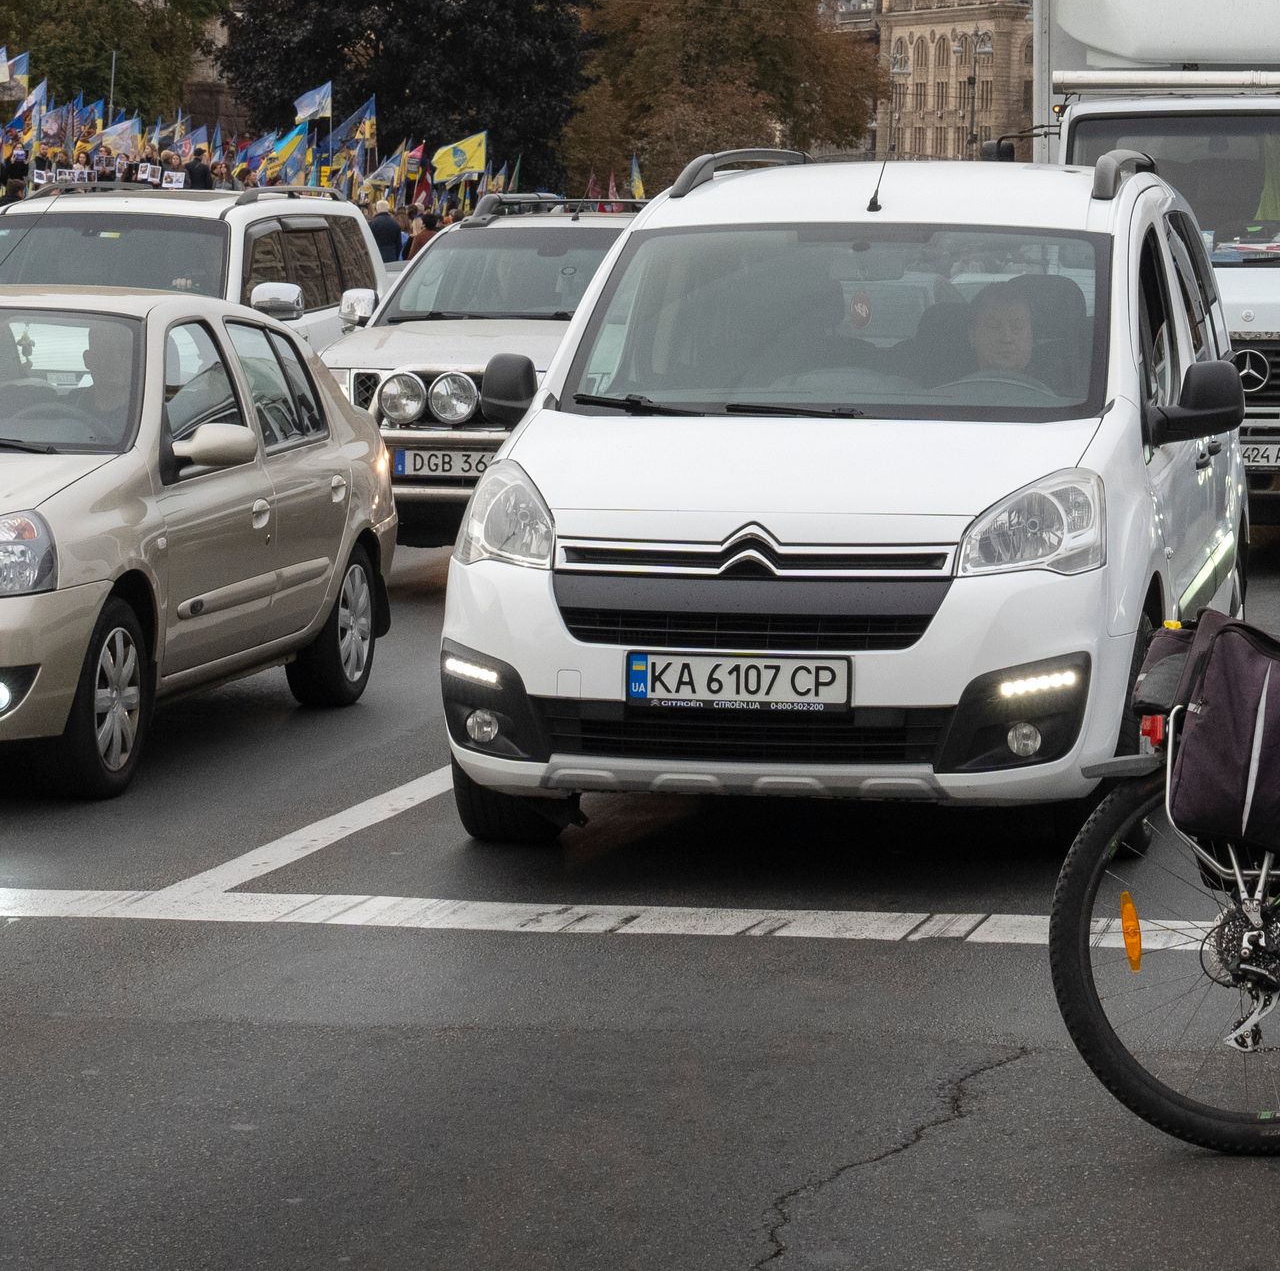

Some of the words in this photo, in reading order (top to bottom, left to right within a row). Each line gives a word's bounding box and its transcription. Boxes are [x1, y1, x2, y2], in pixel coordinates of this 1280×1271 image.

[413, 453, 452, 472] DGB
[461, 454, 494, 473] 36
[632, 682, 646, 692] UA
[650, 662, 697, 694] KA
[706, 663, 781, 696] 6107
[790, 665, 837, 697] CP
[713, 700, 761, 709] CITROËN.UA
[770, 703, 824, 711] 0-800-502-200
